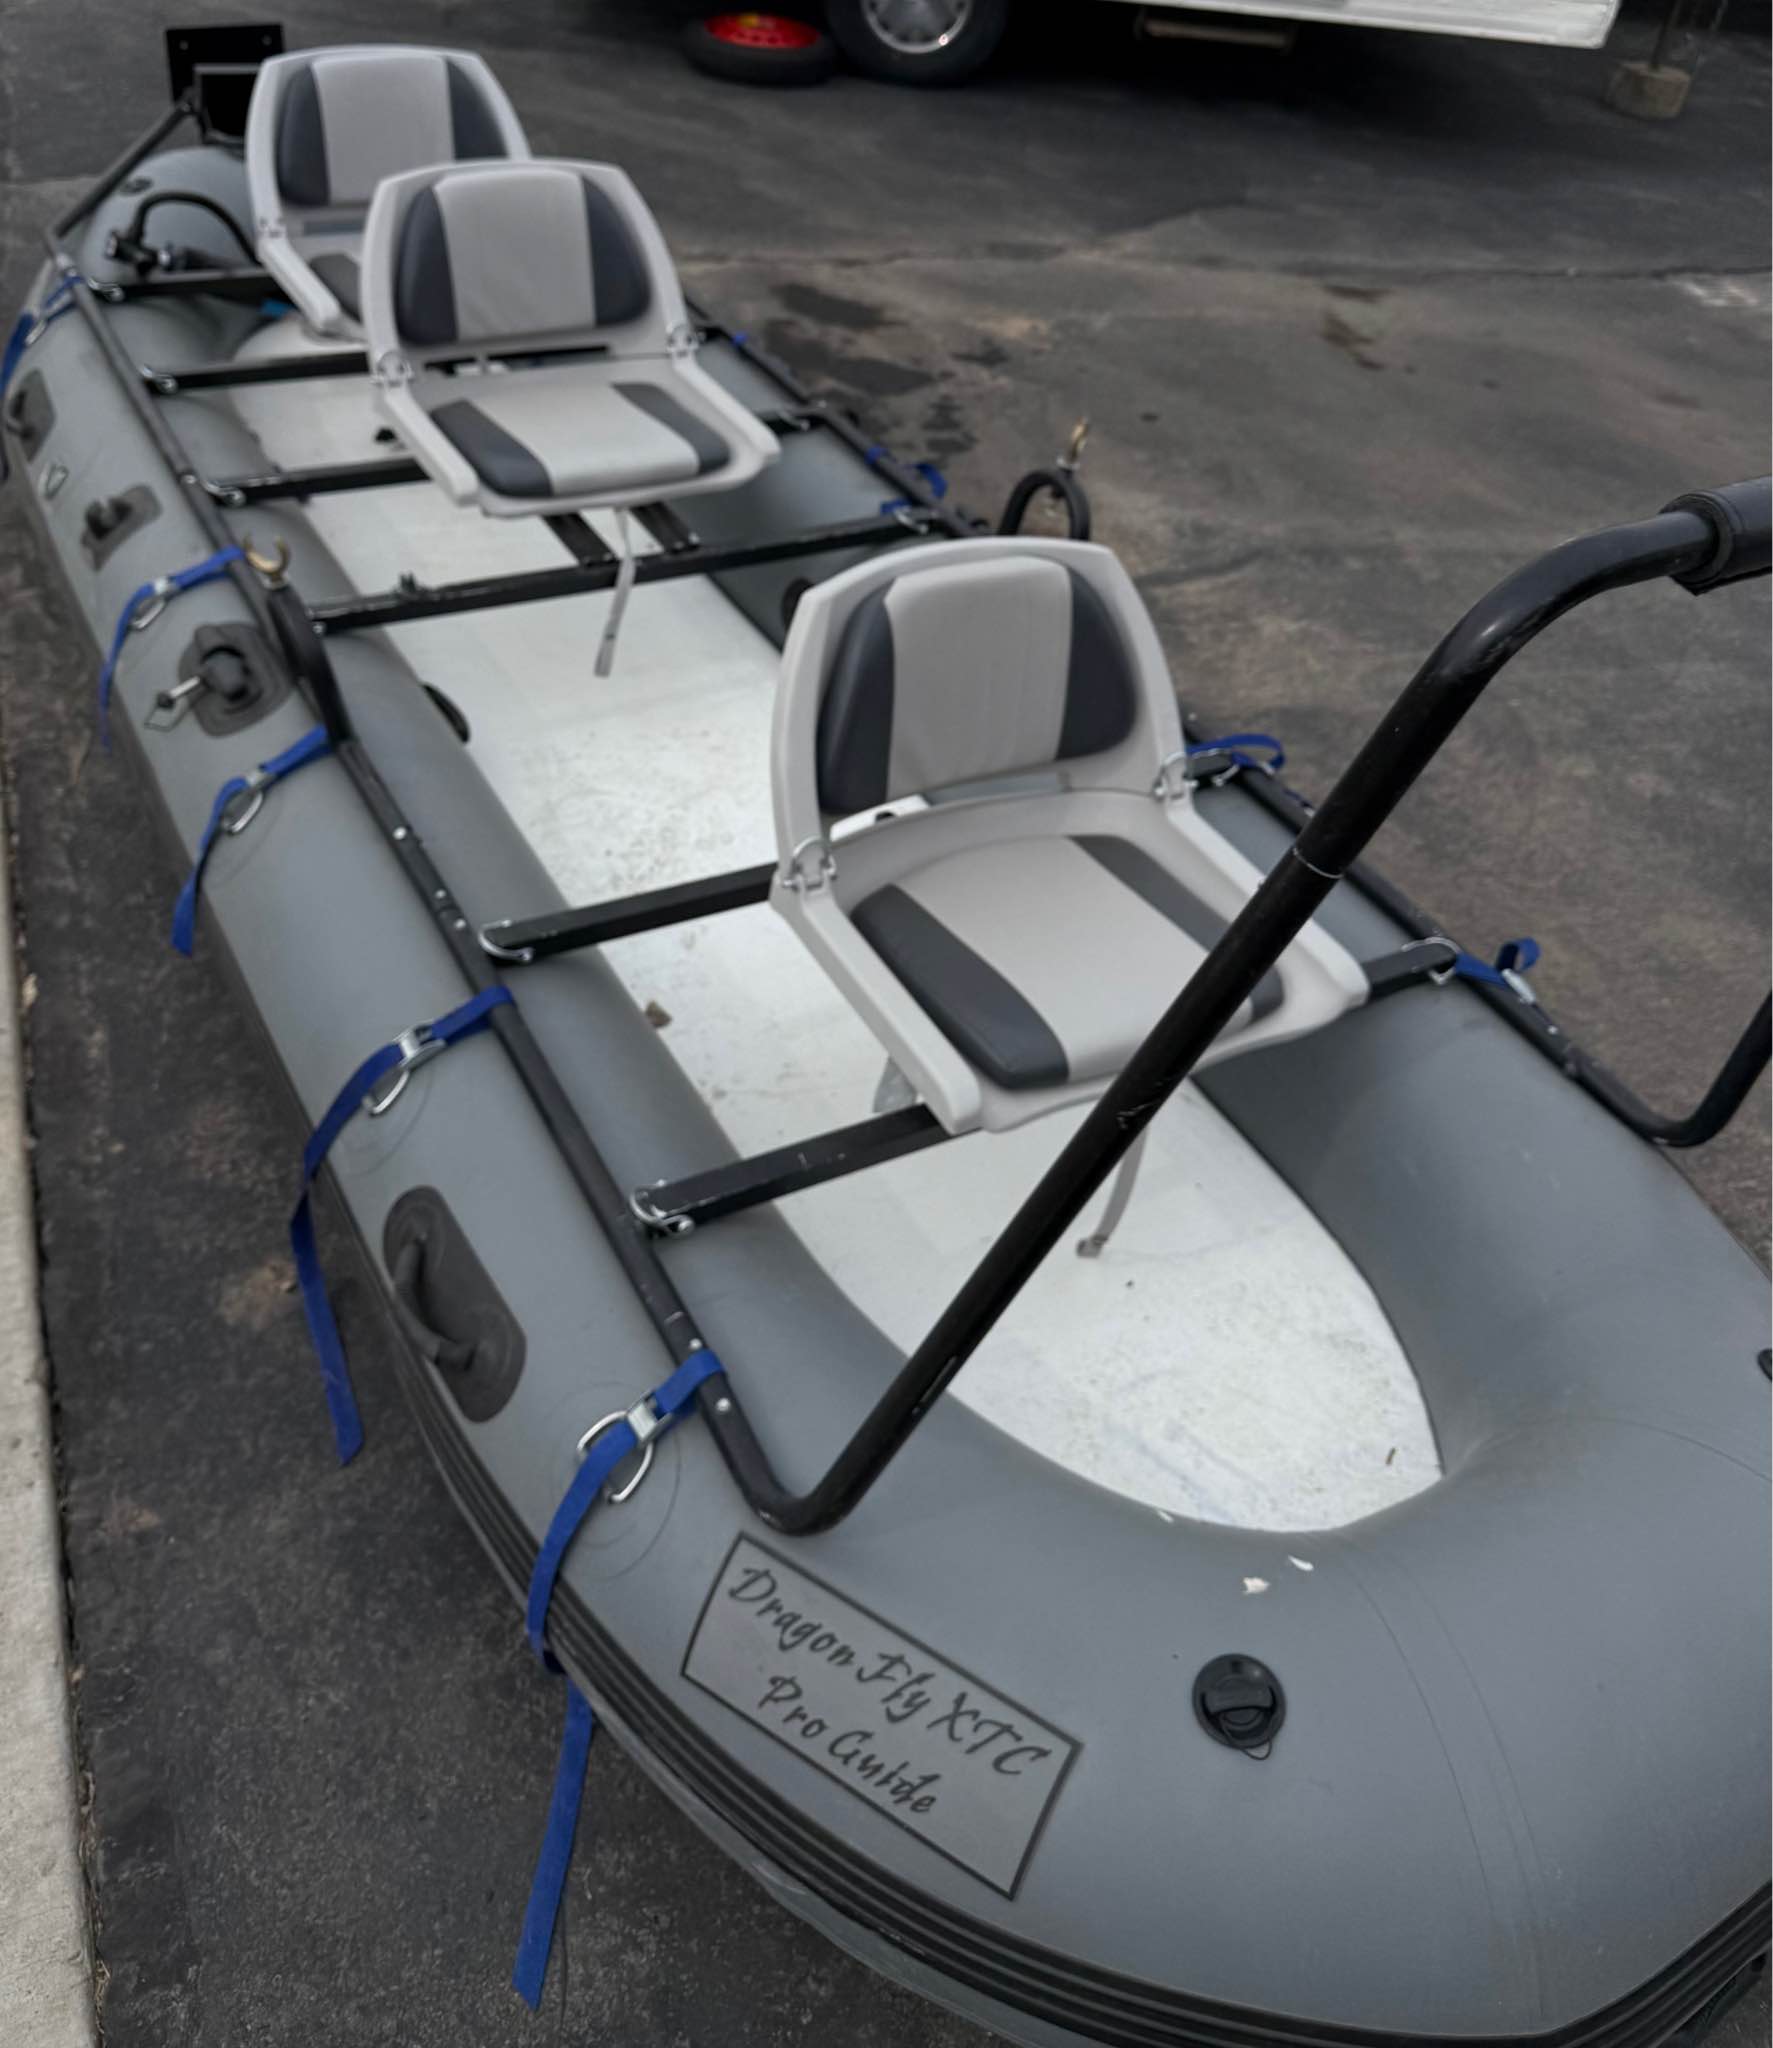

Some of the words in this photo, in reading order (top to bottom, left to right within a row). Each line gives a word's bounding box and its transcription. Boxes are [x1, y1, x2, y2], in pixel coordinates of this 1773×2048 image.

[729, 1568, 854, 1667] Dragon
[856, 1652, 935, 1723] Fly
[926, 1692, 1051, 1775] XTC
[757, 1675, 826, 1738] Pro
[827, 1730, 941, 1813] Guide
